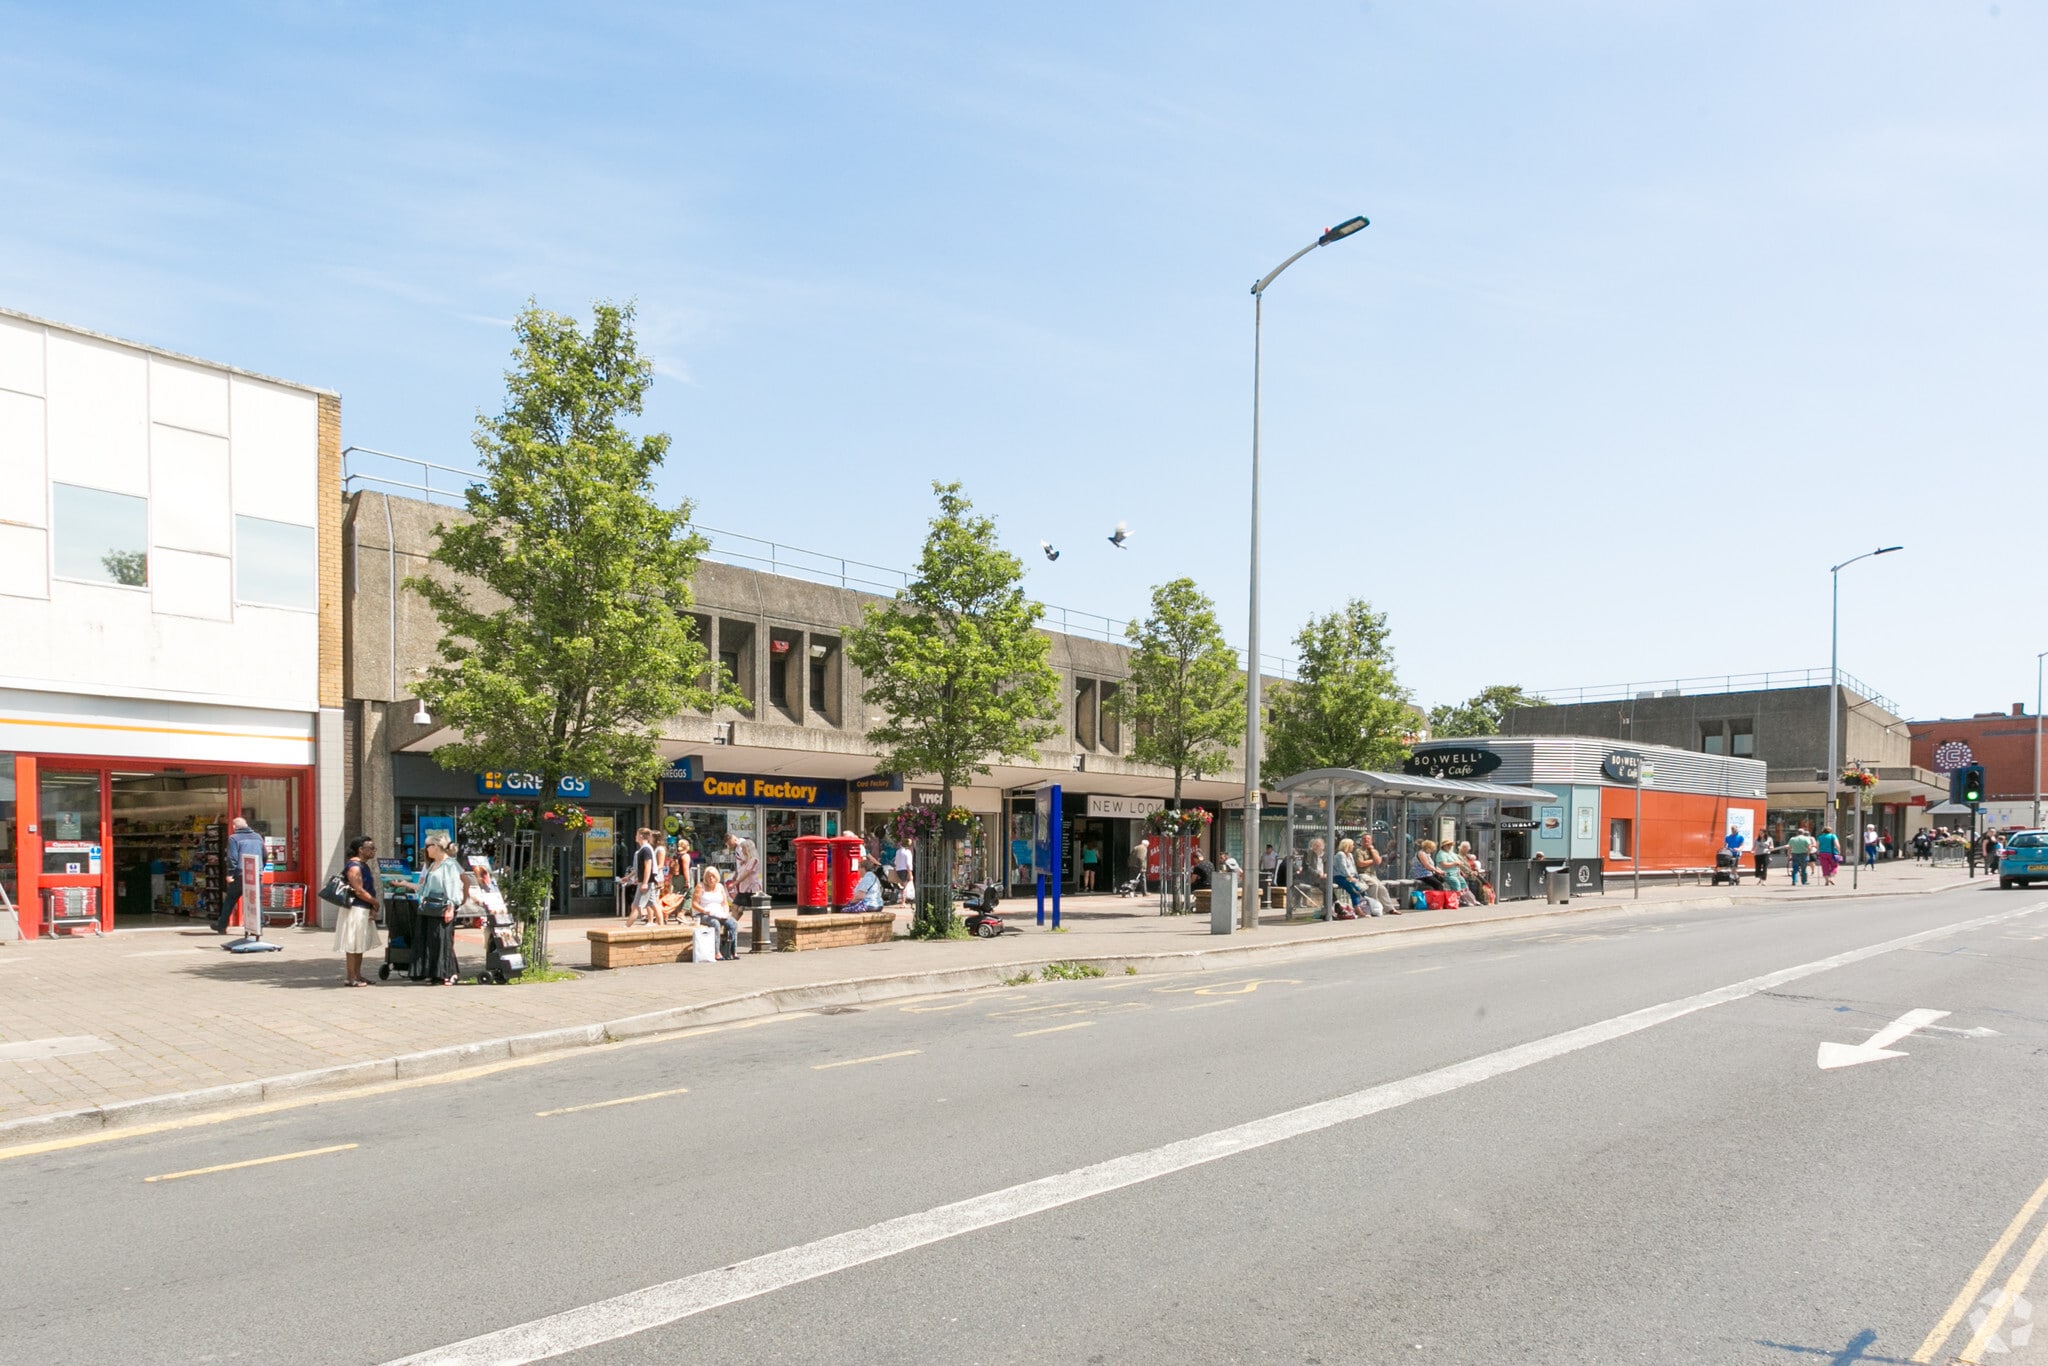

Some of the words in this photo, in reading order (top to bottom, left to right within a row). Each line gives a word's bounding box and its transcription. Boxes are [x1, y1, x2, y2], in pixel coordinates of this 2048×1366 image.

[1448, 764, 1474, 777] Café
[506, 772, 586, 792] GREGS
[856, 780, 869, 788] Card
[869, 779, 889, 788] Factory
[703, 776, 747, 797] Card
[753, 779, 818, 804] Factory
[918, 792, 943, 805] YMC
[1093, 800, 1124, 813] NEW
[1129, 802, 1164, 815] LOOK
